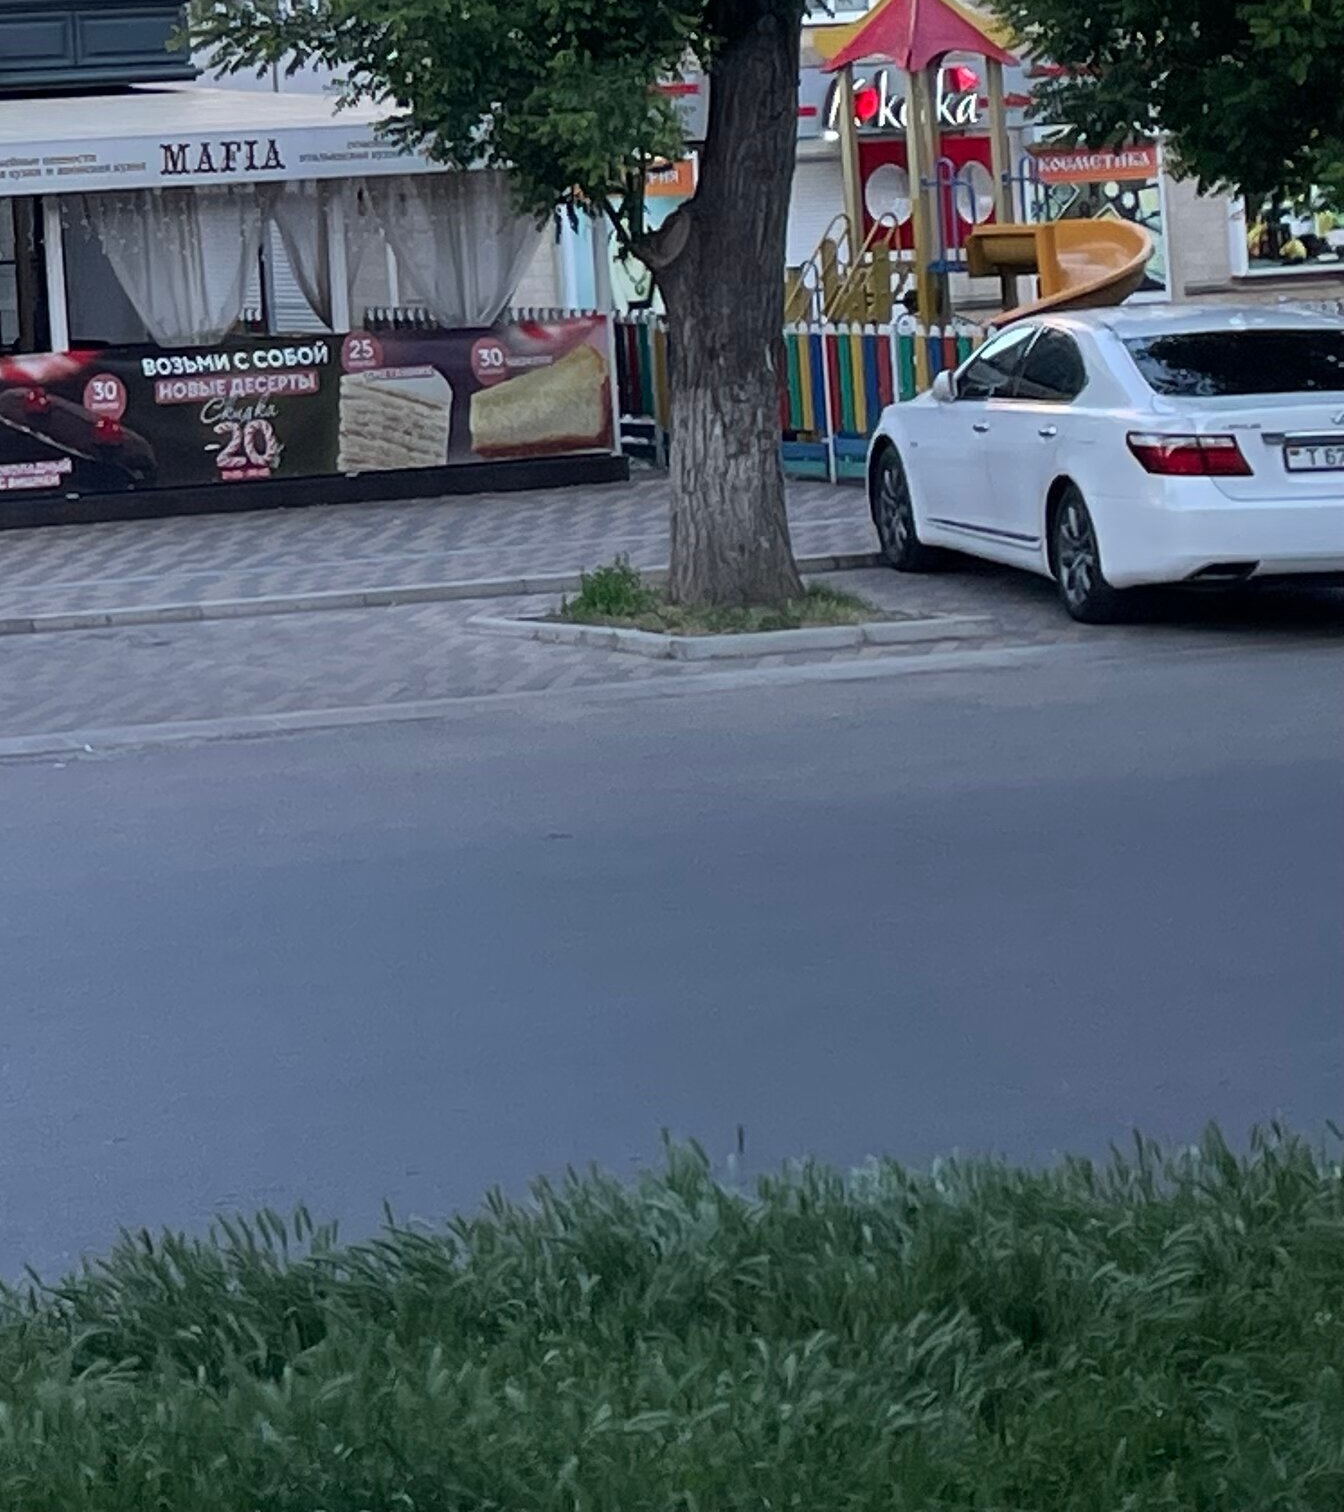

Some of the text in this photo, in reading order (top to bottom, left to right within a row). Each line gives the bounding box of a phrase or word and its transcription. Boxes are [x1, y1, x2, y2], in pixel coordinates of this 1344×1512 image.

[160, 138, 285, 175] MAFIA
[141, 340, 329, 376] ВОЗЬМИ С СОБОЙ
[349, 340, 374, 359] 25
[478, 348, 503, 367] 30
[92, 380, 118, 401] 30
[158, 373, 317, 400] НОВЫЕ ДЕСЕРТЫ
